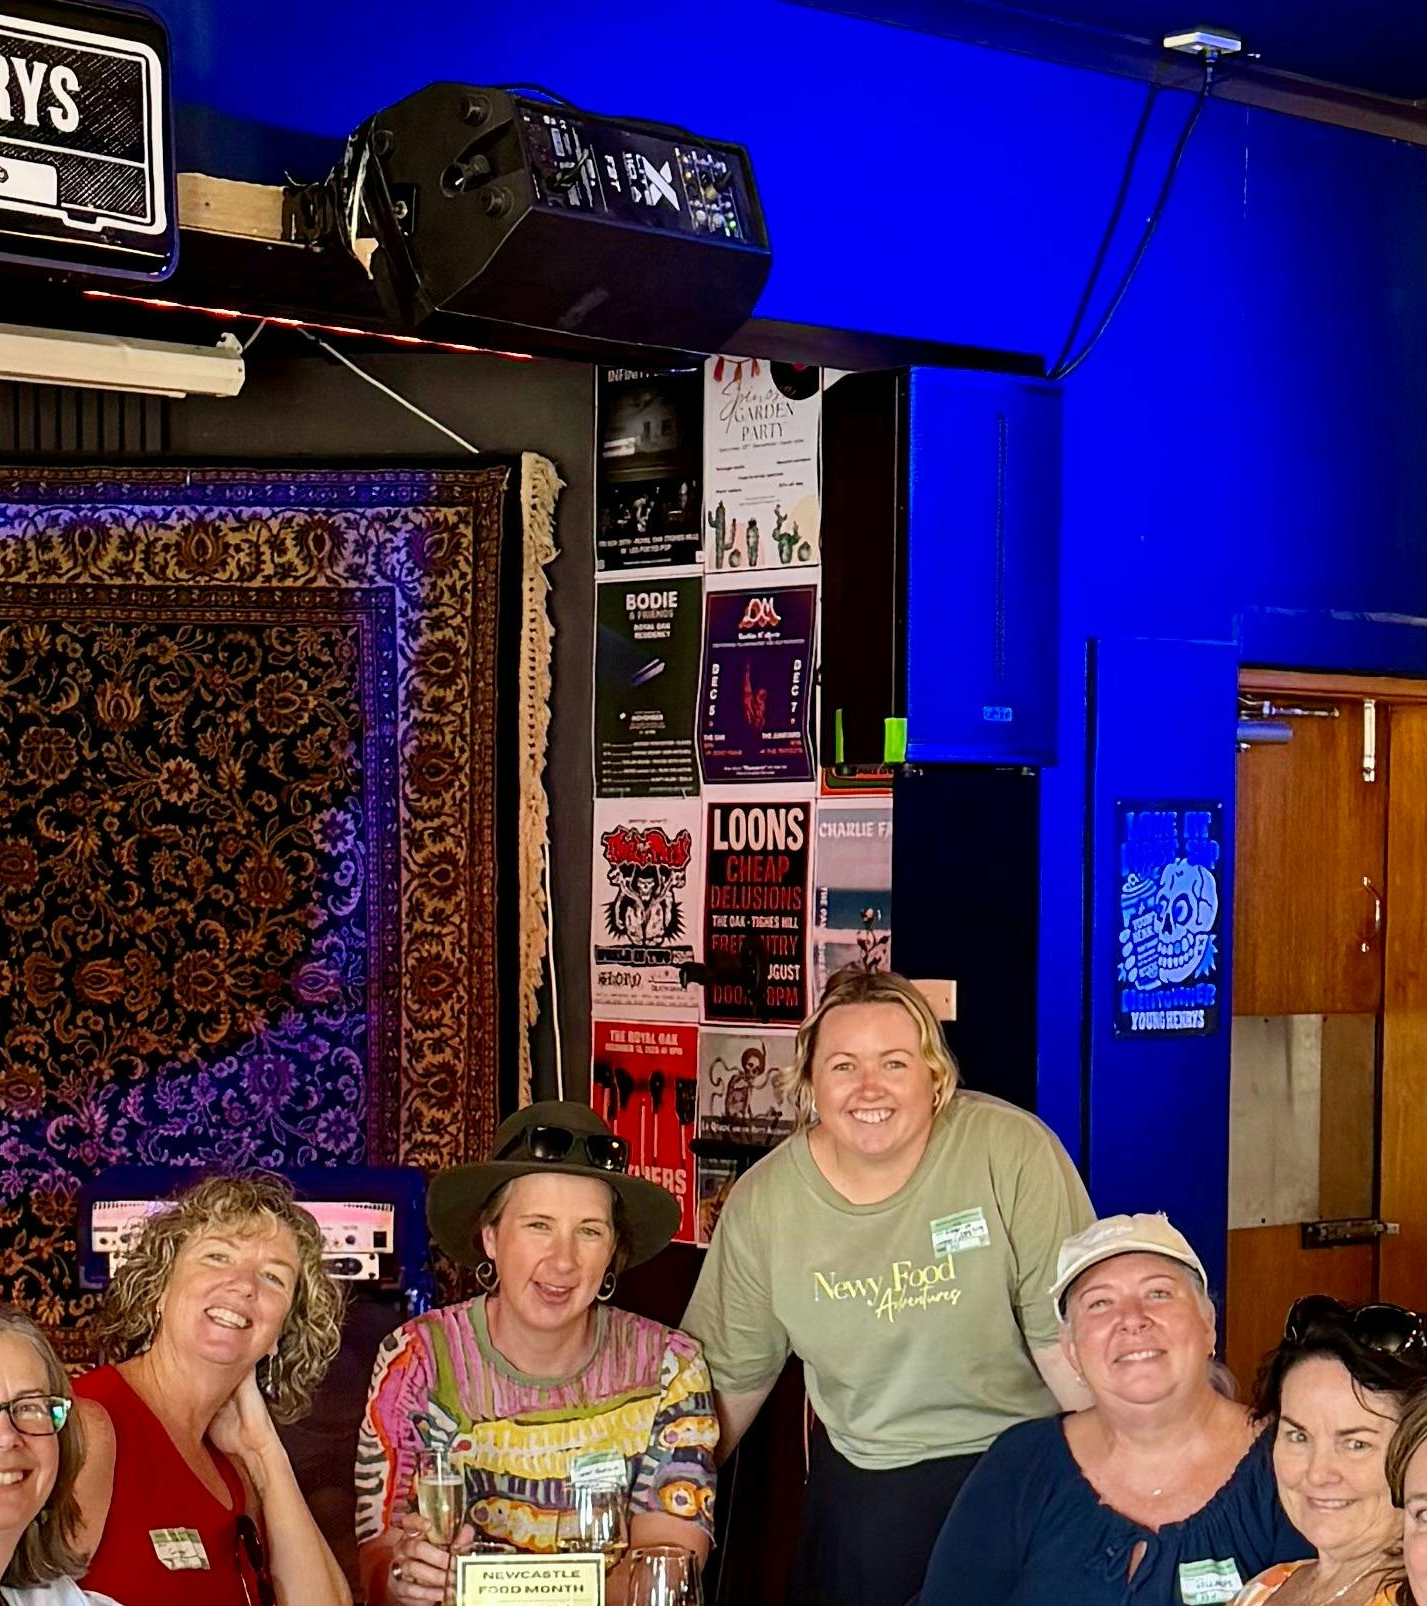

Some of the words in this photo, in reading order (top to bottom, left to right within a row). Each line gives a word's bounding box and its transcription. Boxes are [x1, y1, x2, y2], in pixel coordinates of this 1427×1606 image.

[734, 402, 794, 422] GARDEN
[741, 422, 787, 441] PARTY
[626, 591, 678, 611] BODIE
[709, 663, 720, 700] DEC
[790, 659, 802, 697] DEC
[790, 701, 798, 713] 7
[713, 807, 805, 851] LOONS
[819, 822, 874, 838] CHARLIE
[725, 855, 790, 884] CHEAP
[710, 885, 802, 911] DELUSIONS
[712, 915, 728, 928] THE
[729, 915, 746, 928] OAK
[1131, 1011, 1165, 1030] YOUNG
[1166, 1010, 1205, 1029] HENRYS
[812, 1271, 883, 1306] Newy
[892, 1253, 957, 1292] Food
[482, 1569, 581, 1580] NEWCASTLE
[478, 1585, 522, 1594] FOOD
[524, 1584, 584, 1594] MONTH
